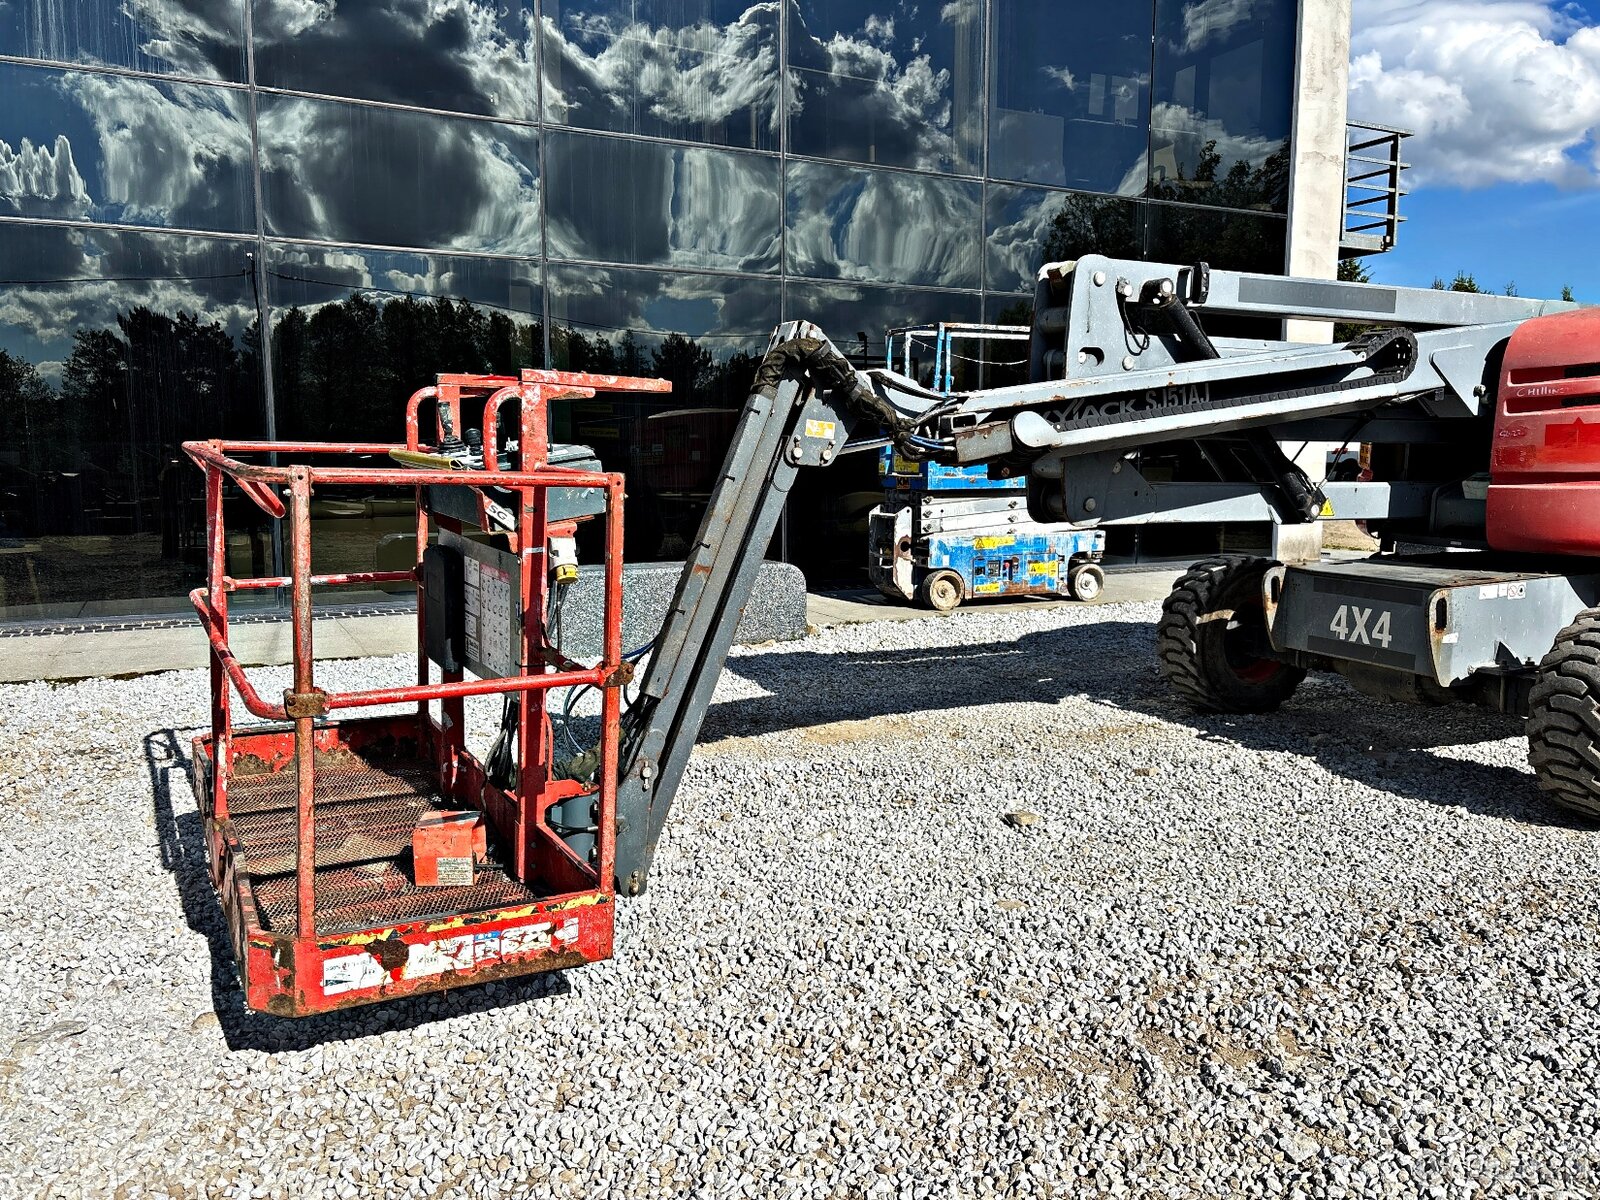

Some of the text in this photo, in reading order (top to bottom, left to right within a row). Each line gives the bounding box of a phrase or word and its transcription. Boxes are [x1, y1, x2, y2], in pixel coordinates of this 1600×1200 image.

[1144, 382, 1210, 411] SJ51AJ
[488, 504, 508, 521] SG
[1329, 604, 1393, 648] 4X4
